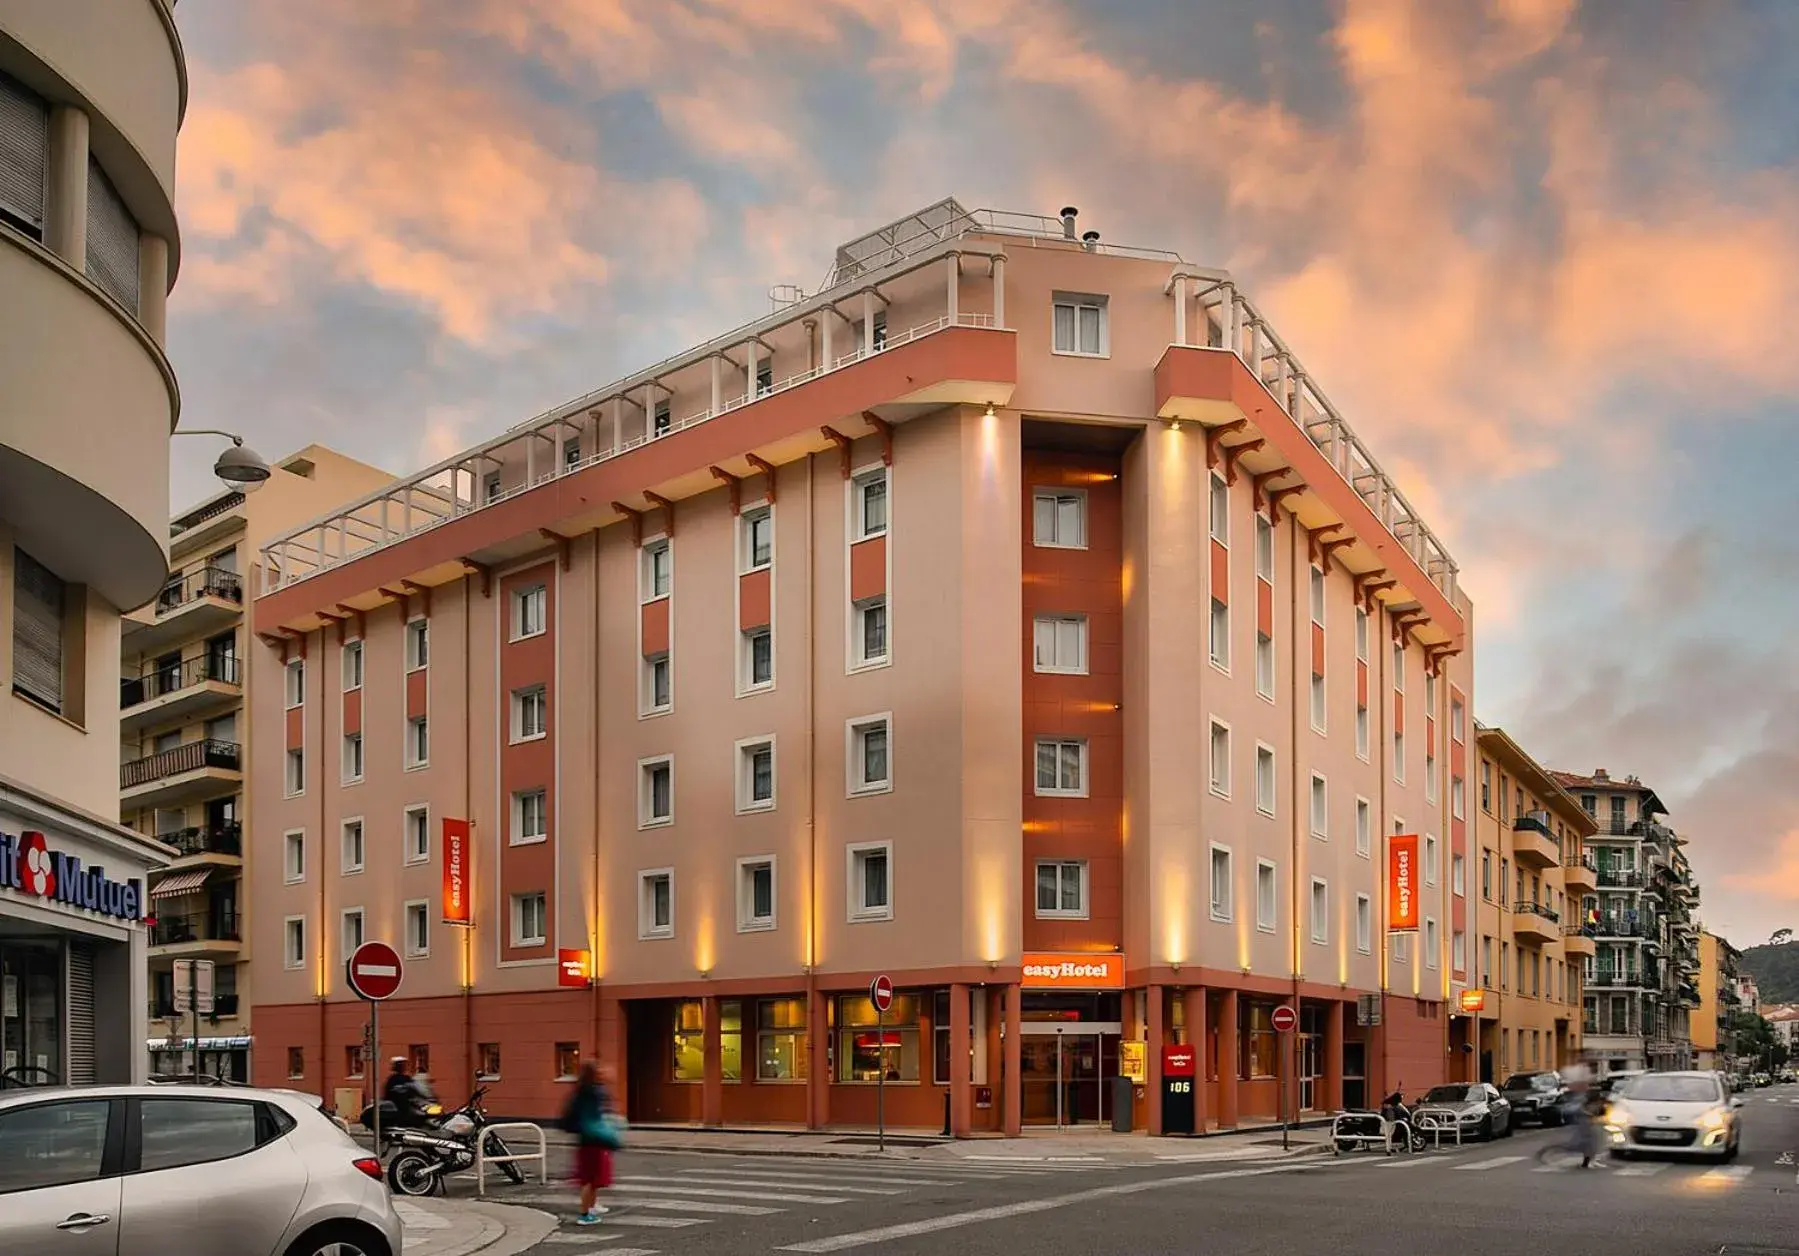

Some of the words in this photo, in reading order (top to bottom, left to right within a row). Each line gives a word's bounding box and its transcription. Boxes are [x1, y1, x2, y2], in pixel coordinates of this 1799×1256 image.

[53, 850, 142, 921] Mutuel
[450, 835, 462, 908] easyHotel
[1397, 850, 1412, 917] easyHotel
[1022, 962, 1108, 980] easyHotel
[1170, 1081, 1191, 1093] 106
